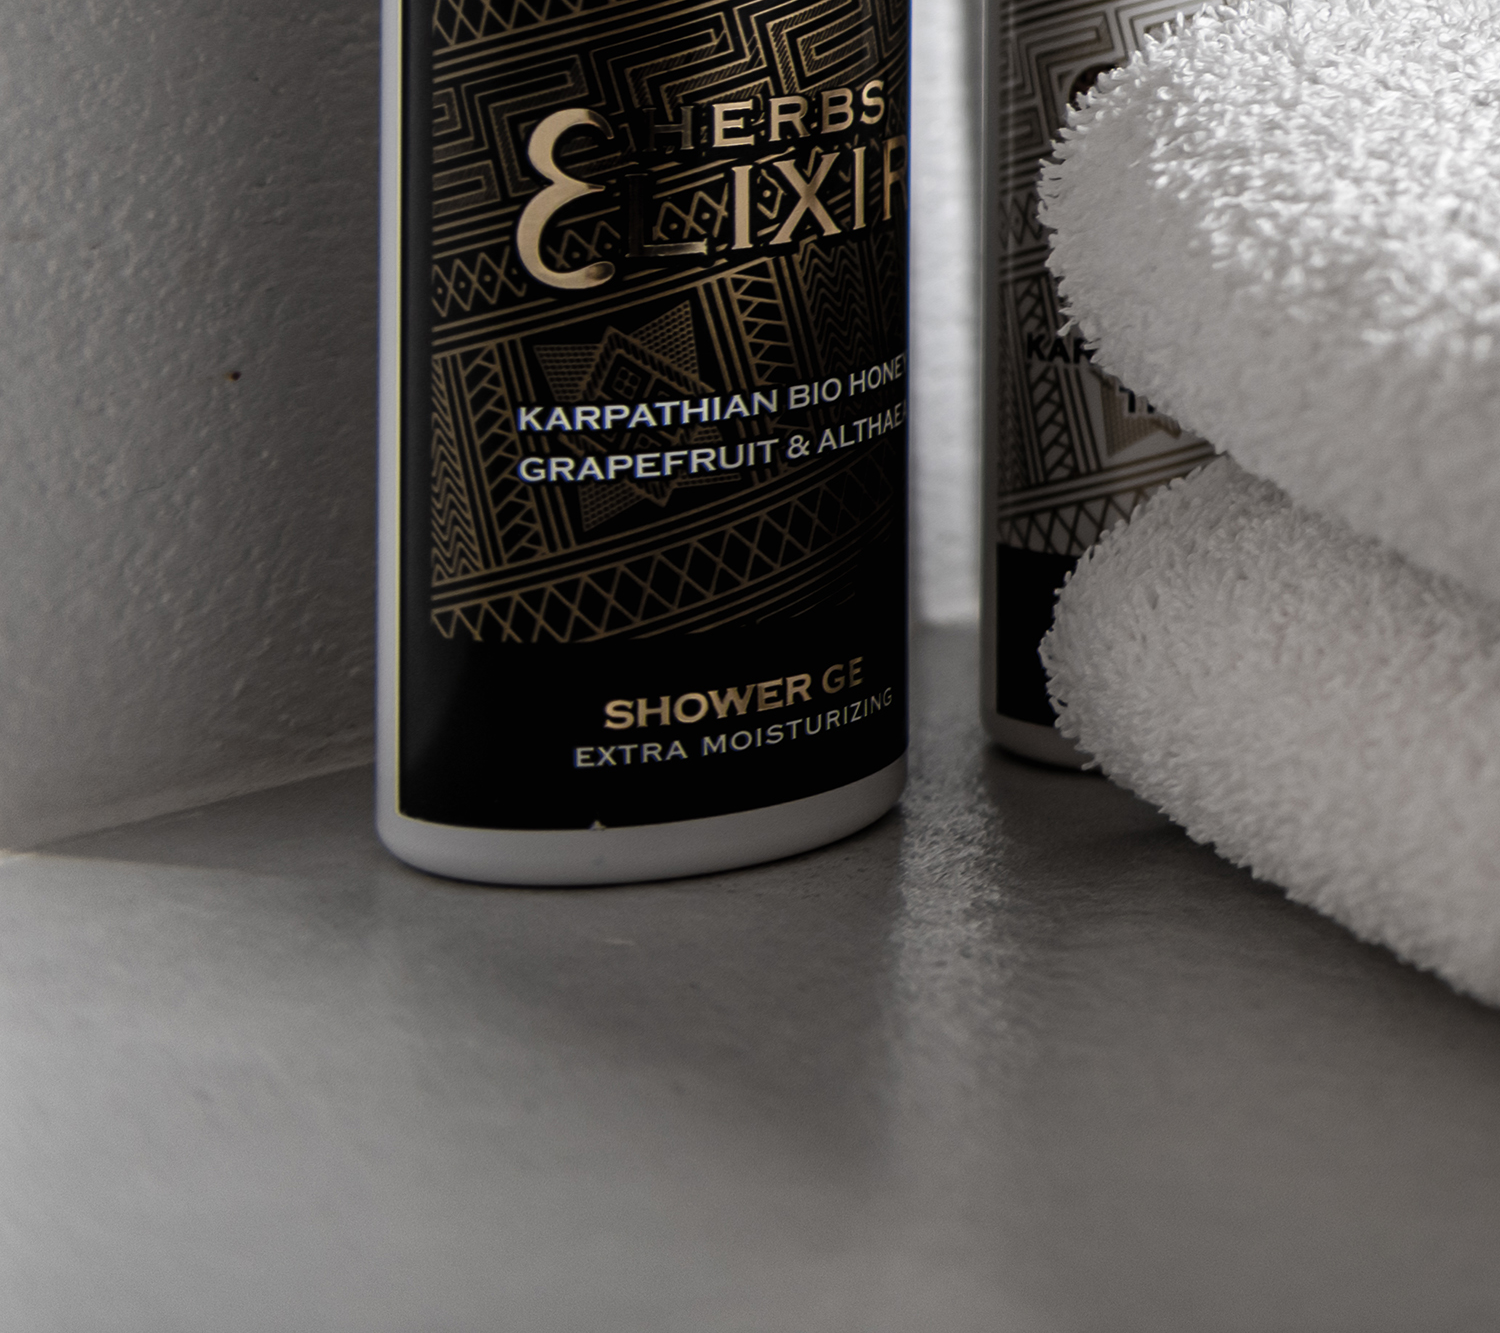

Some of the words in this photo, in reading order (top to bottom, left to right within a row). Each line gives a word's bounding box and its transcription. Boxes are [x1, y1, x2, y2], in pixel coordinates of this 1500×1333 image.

[641, 80, 886, 153] HERBS
[518, 389, 779, 431] KARPATHIAN
[788, 377, 843, 410] BIO
[518, 438, 780, 482] GRAPEFRUIT
[786, 434, 812, 460] &
[816, 400, 906, 454] ALTHAE
[574, 739, 689, 769] EXTRA
[701, 686, 893, 757] MOISTURIZING
[603, 673, 813, 730] SHOWER
[821, 656, 866, 695] GE
